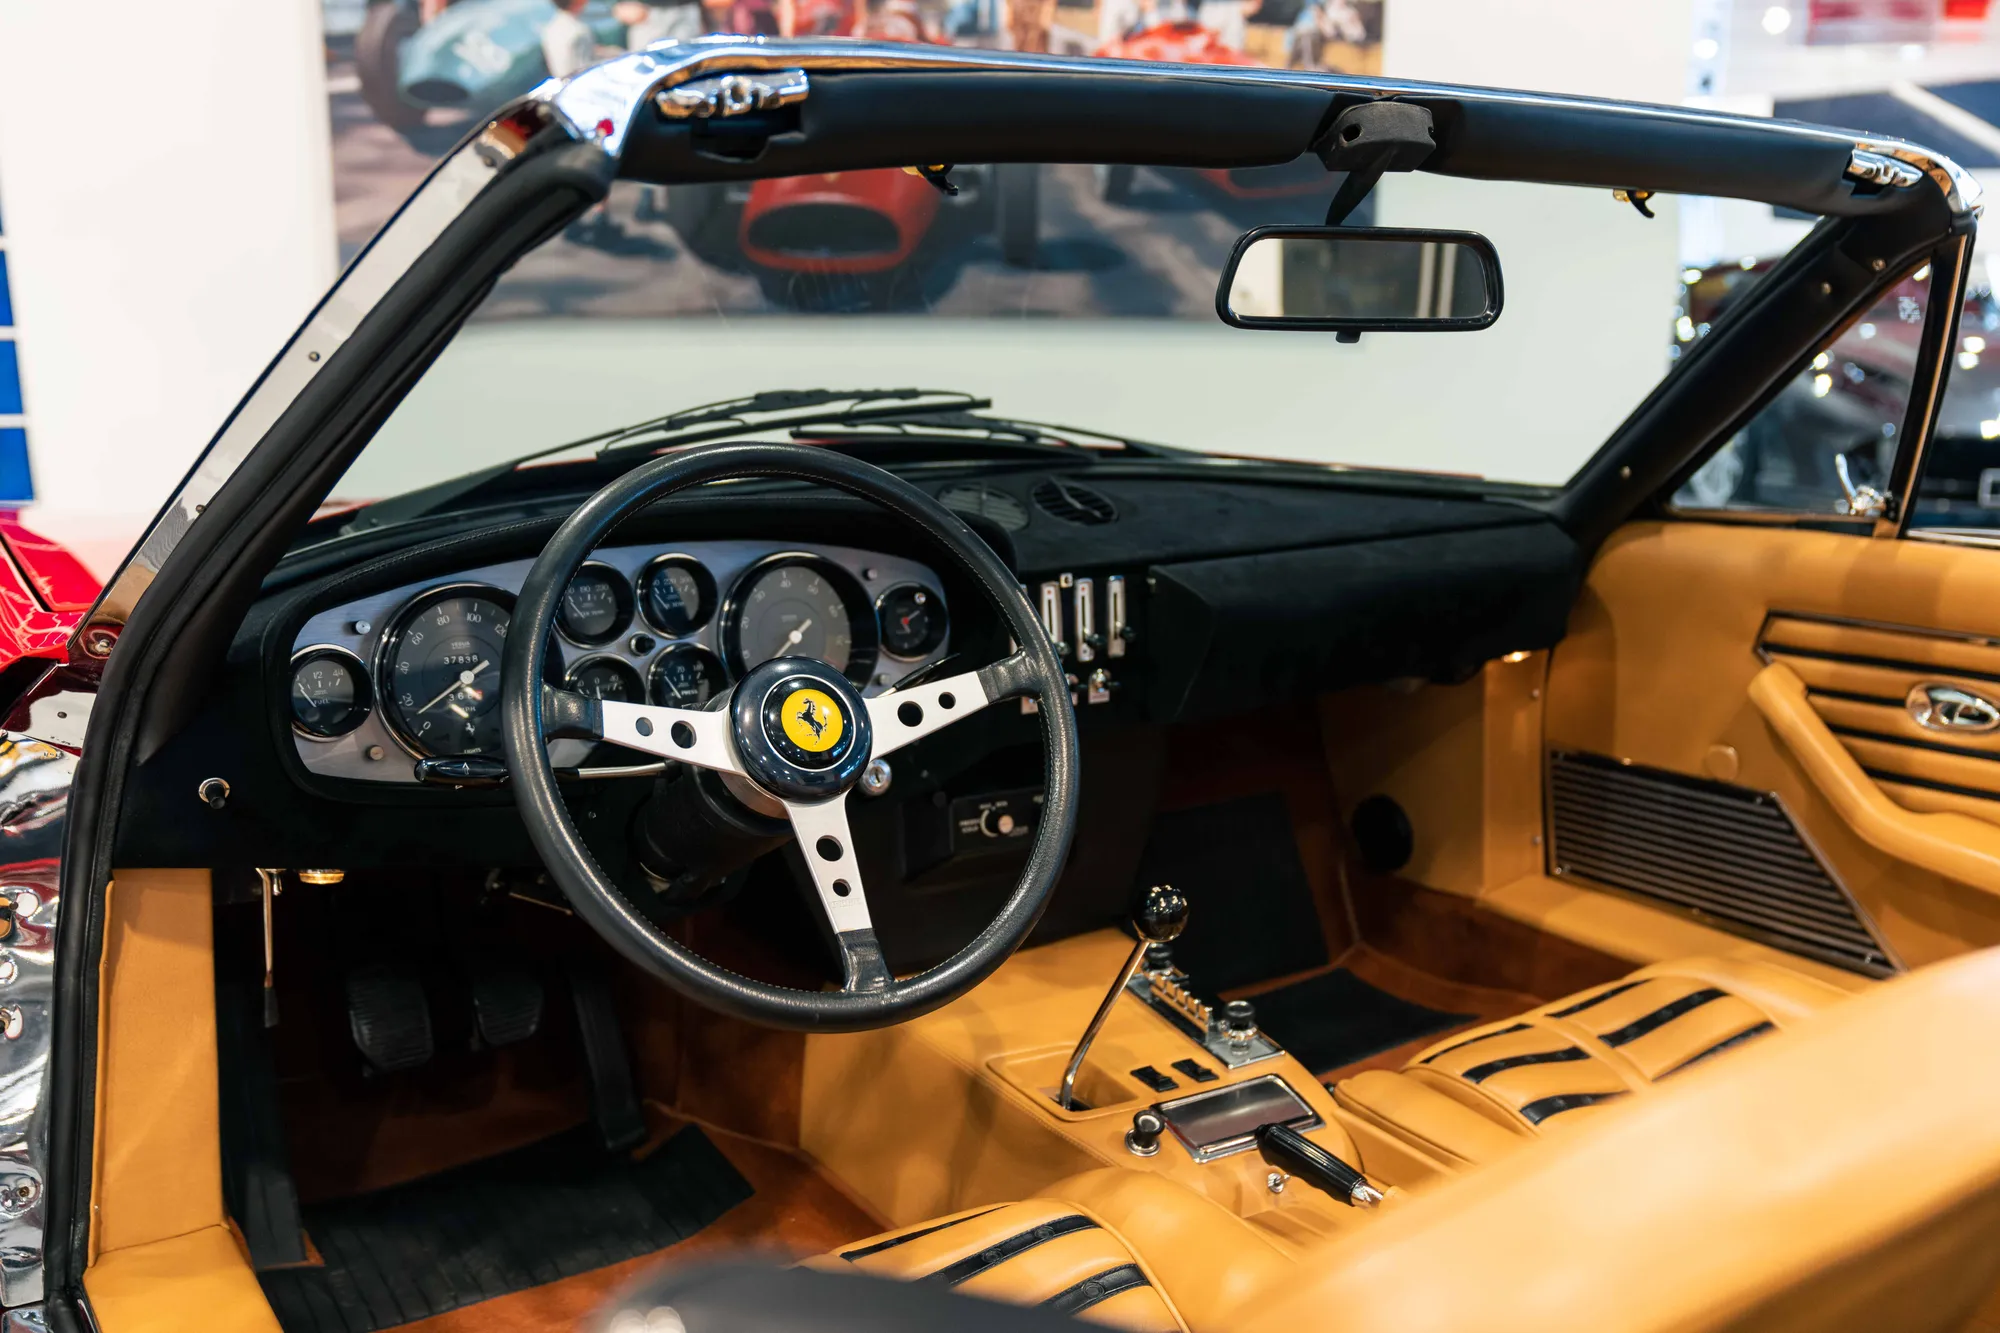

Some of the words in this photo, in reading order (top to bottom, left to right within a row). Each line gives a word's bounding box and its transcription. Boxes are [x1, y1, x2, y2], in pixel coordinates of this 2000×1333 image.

[436, 614, 450, 626] 80
[466, 612, 482, 623] 100
[411, 632, 424, 646] 60
[443, 654, 479, 665] 37838
[400, 661, 410, 675] 40
[402, 692, 415, 707] 20
[422, 721, 432, 730] 0
